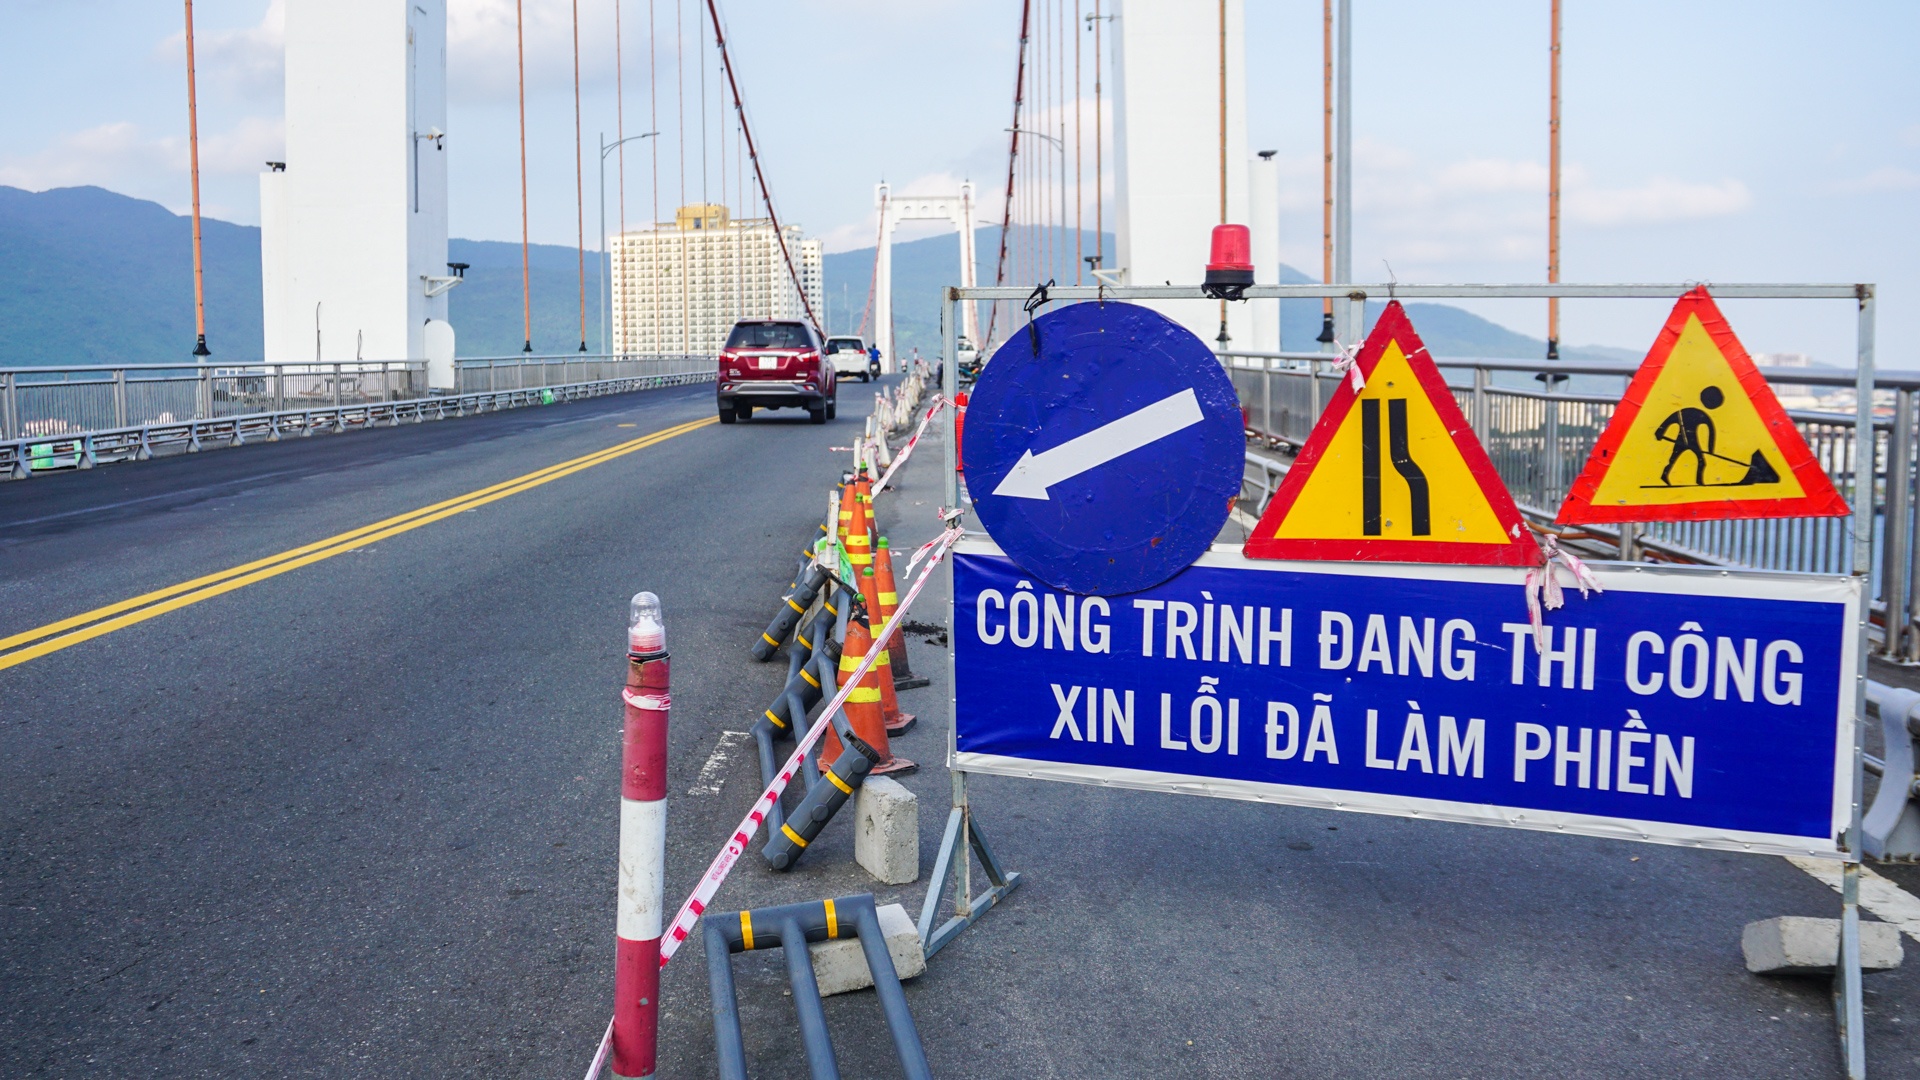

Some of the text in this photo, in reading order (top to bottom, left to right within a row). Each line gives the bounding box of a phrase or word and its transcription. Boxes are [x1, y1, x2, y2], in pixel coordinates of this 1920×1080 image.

[976, 580, 1804, 706] CÔNG TRÌNH ĐANG THI CÔNG
[1050, 676, 1695, 799] XIN LỖI ĐÃ LÀM PHIỀN
